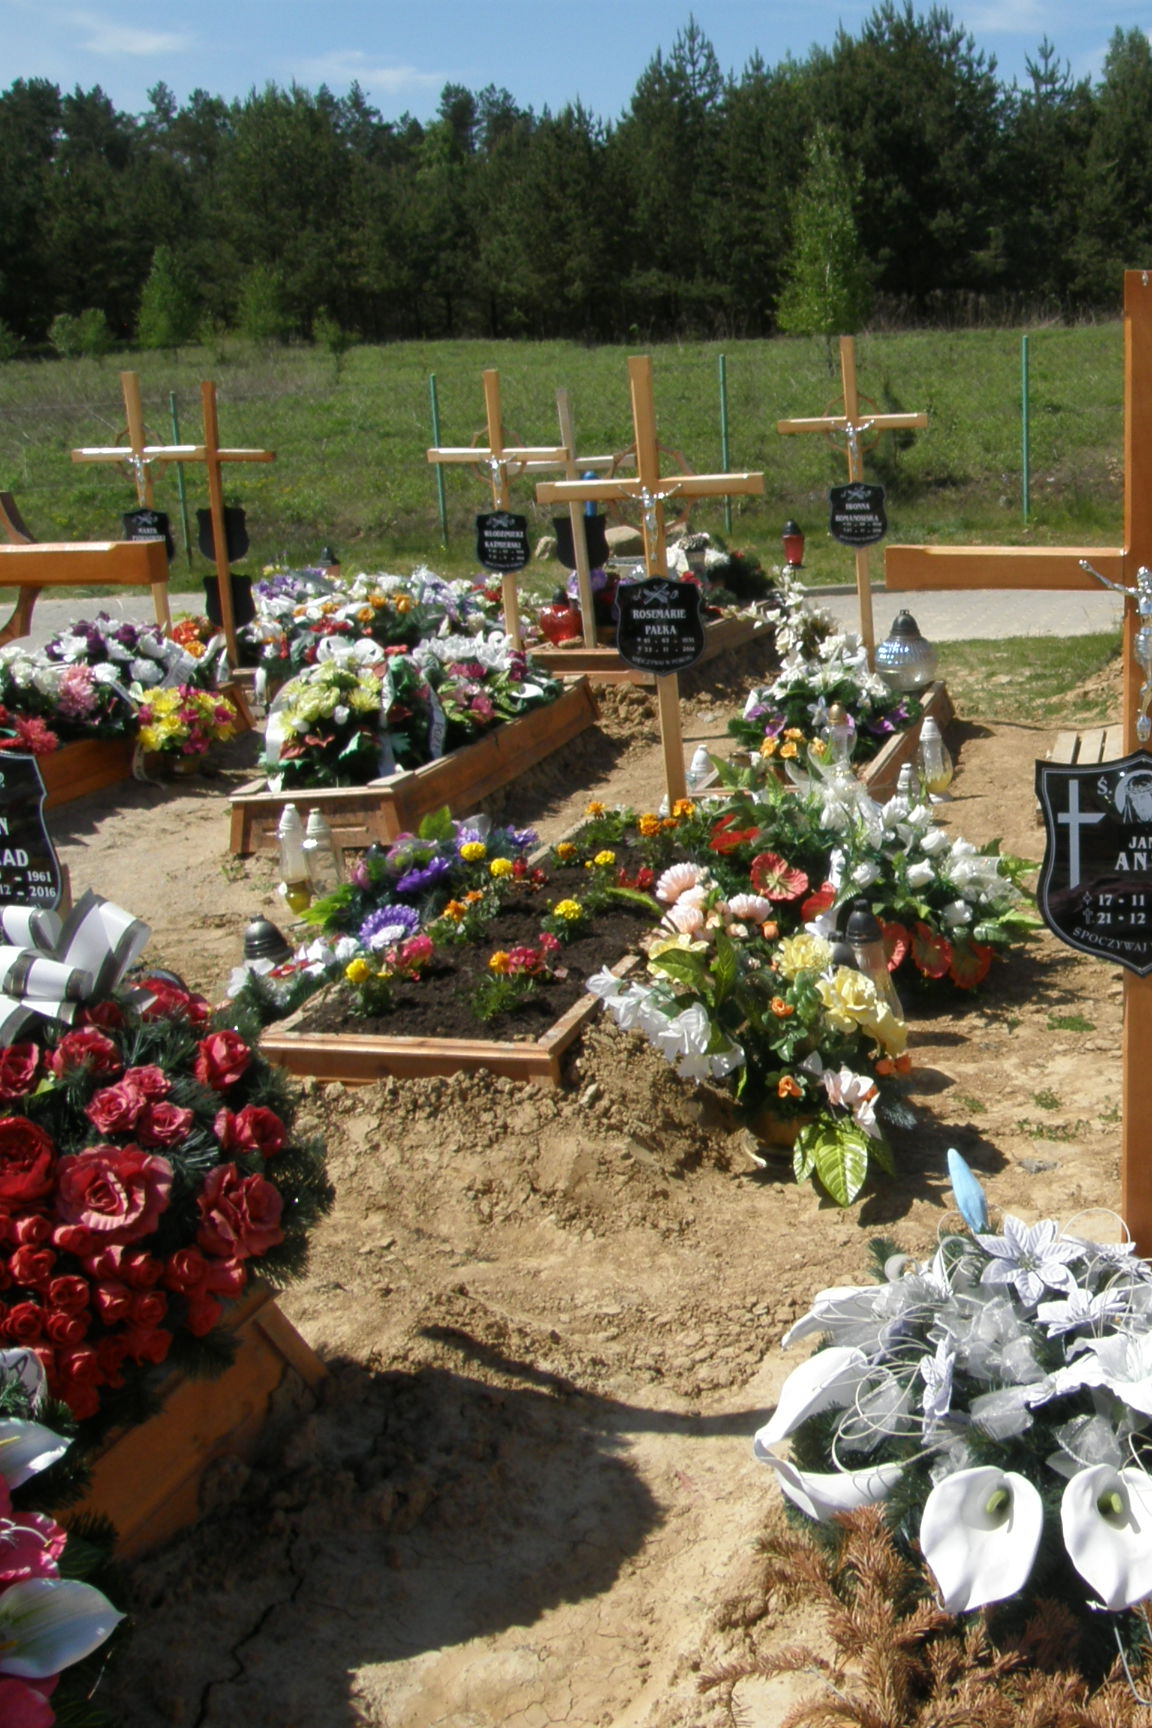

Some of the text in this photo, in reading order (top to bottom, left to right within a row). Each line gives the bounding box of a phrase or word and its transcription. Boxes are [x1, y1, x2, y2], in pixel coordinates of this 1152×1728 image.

[632, 608, 687, 619] ROSEMARIE
[27, 870, 52, 883] 1961
[29, 885, 57, 898] 2016
[1098, 894, 1113, 907] 17
[1131, 894, 1146, 907] 11
[1096, 912, 1112, 925] 21
[1130, 912, 1146, 925] 12
[1072, 926, 1148, 953] SPOCZYWAJ
